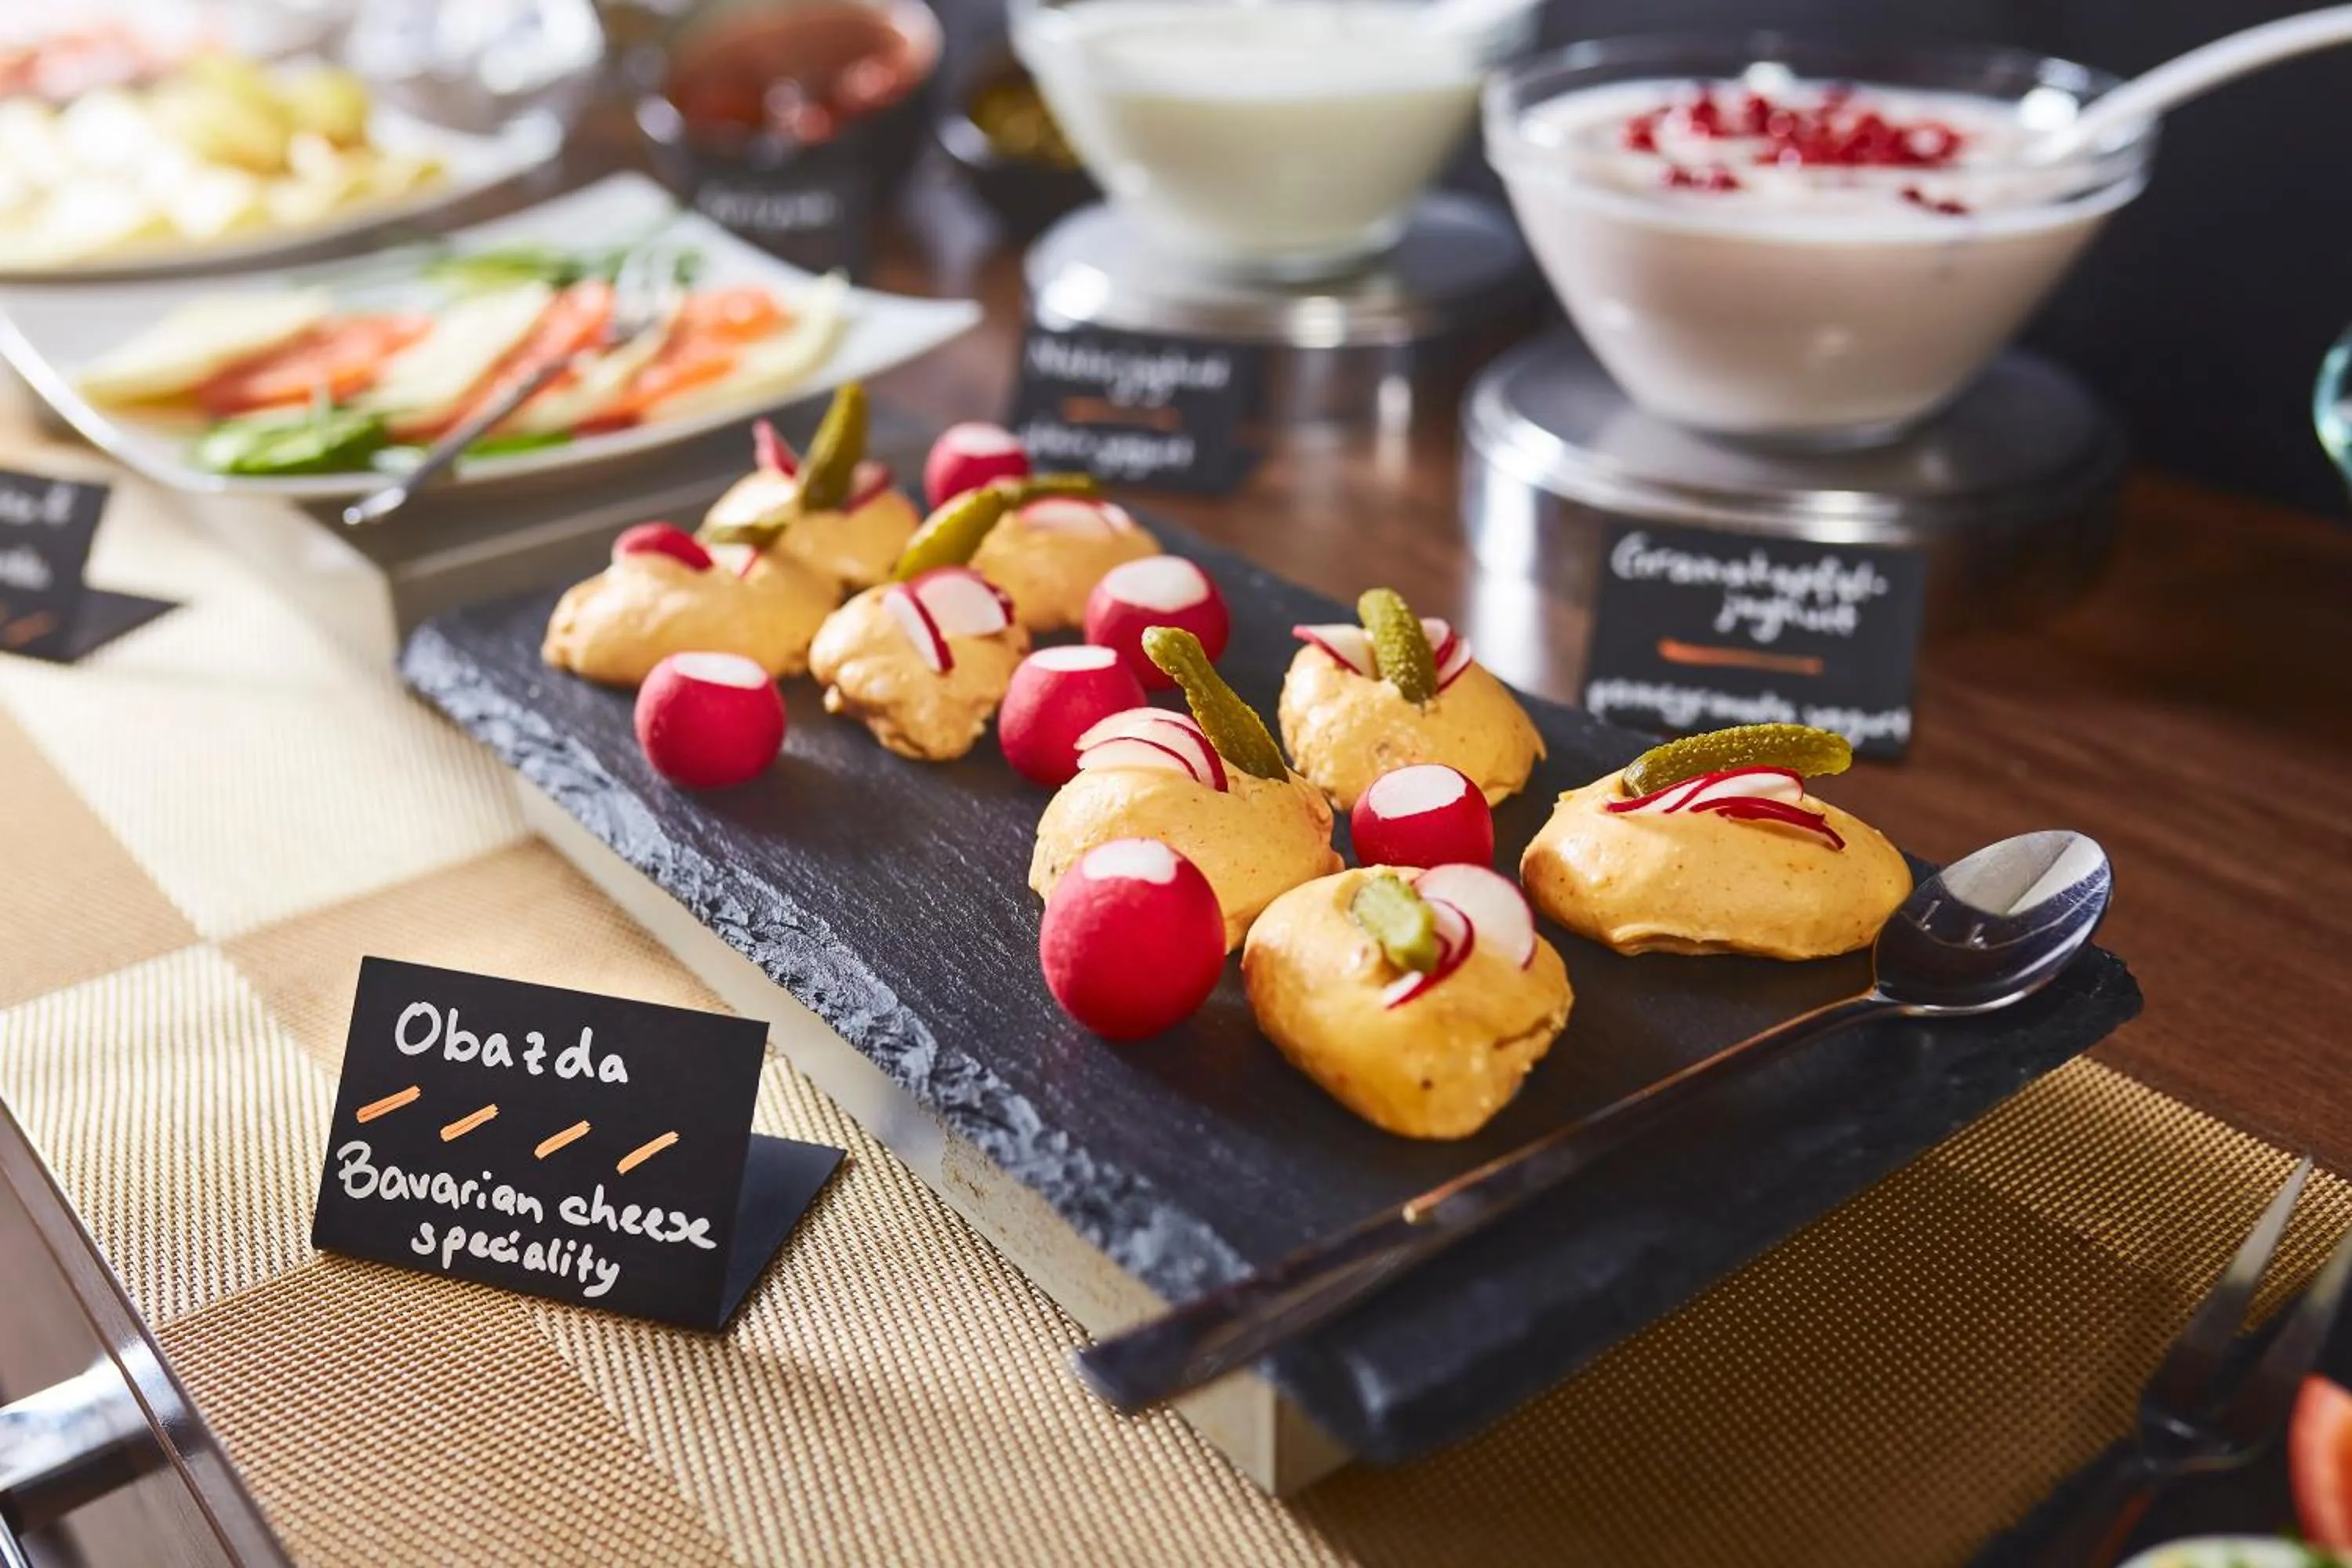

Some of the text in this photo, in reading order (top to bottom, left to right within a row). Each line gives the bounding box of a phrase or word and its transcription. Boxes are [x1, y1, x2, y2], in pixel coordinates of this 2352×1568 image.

[394, 1001, 629, 1083] Obazda
[336, 1141, 717, 1249] Bavarian cheese
[410, 1222, 619, 1298] speciality
